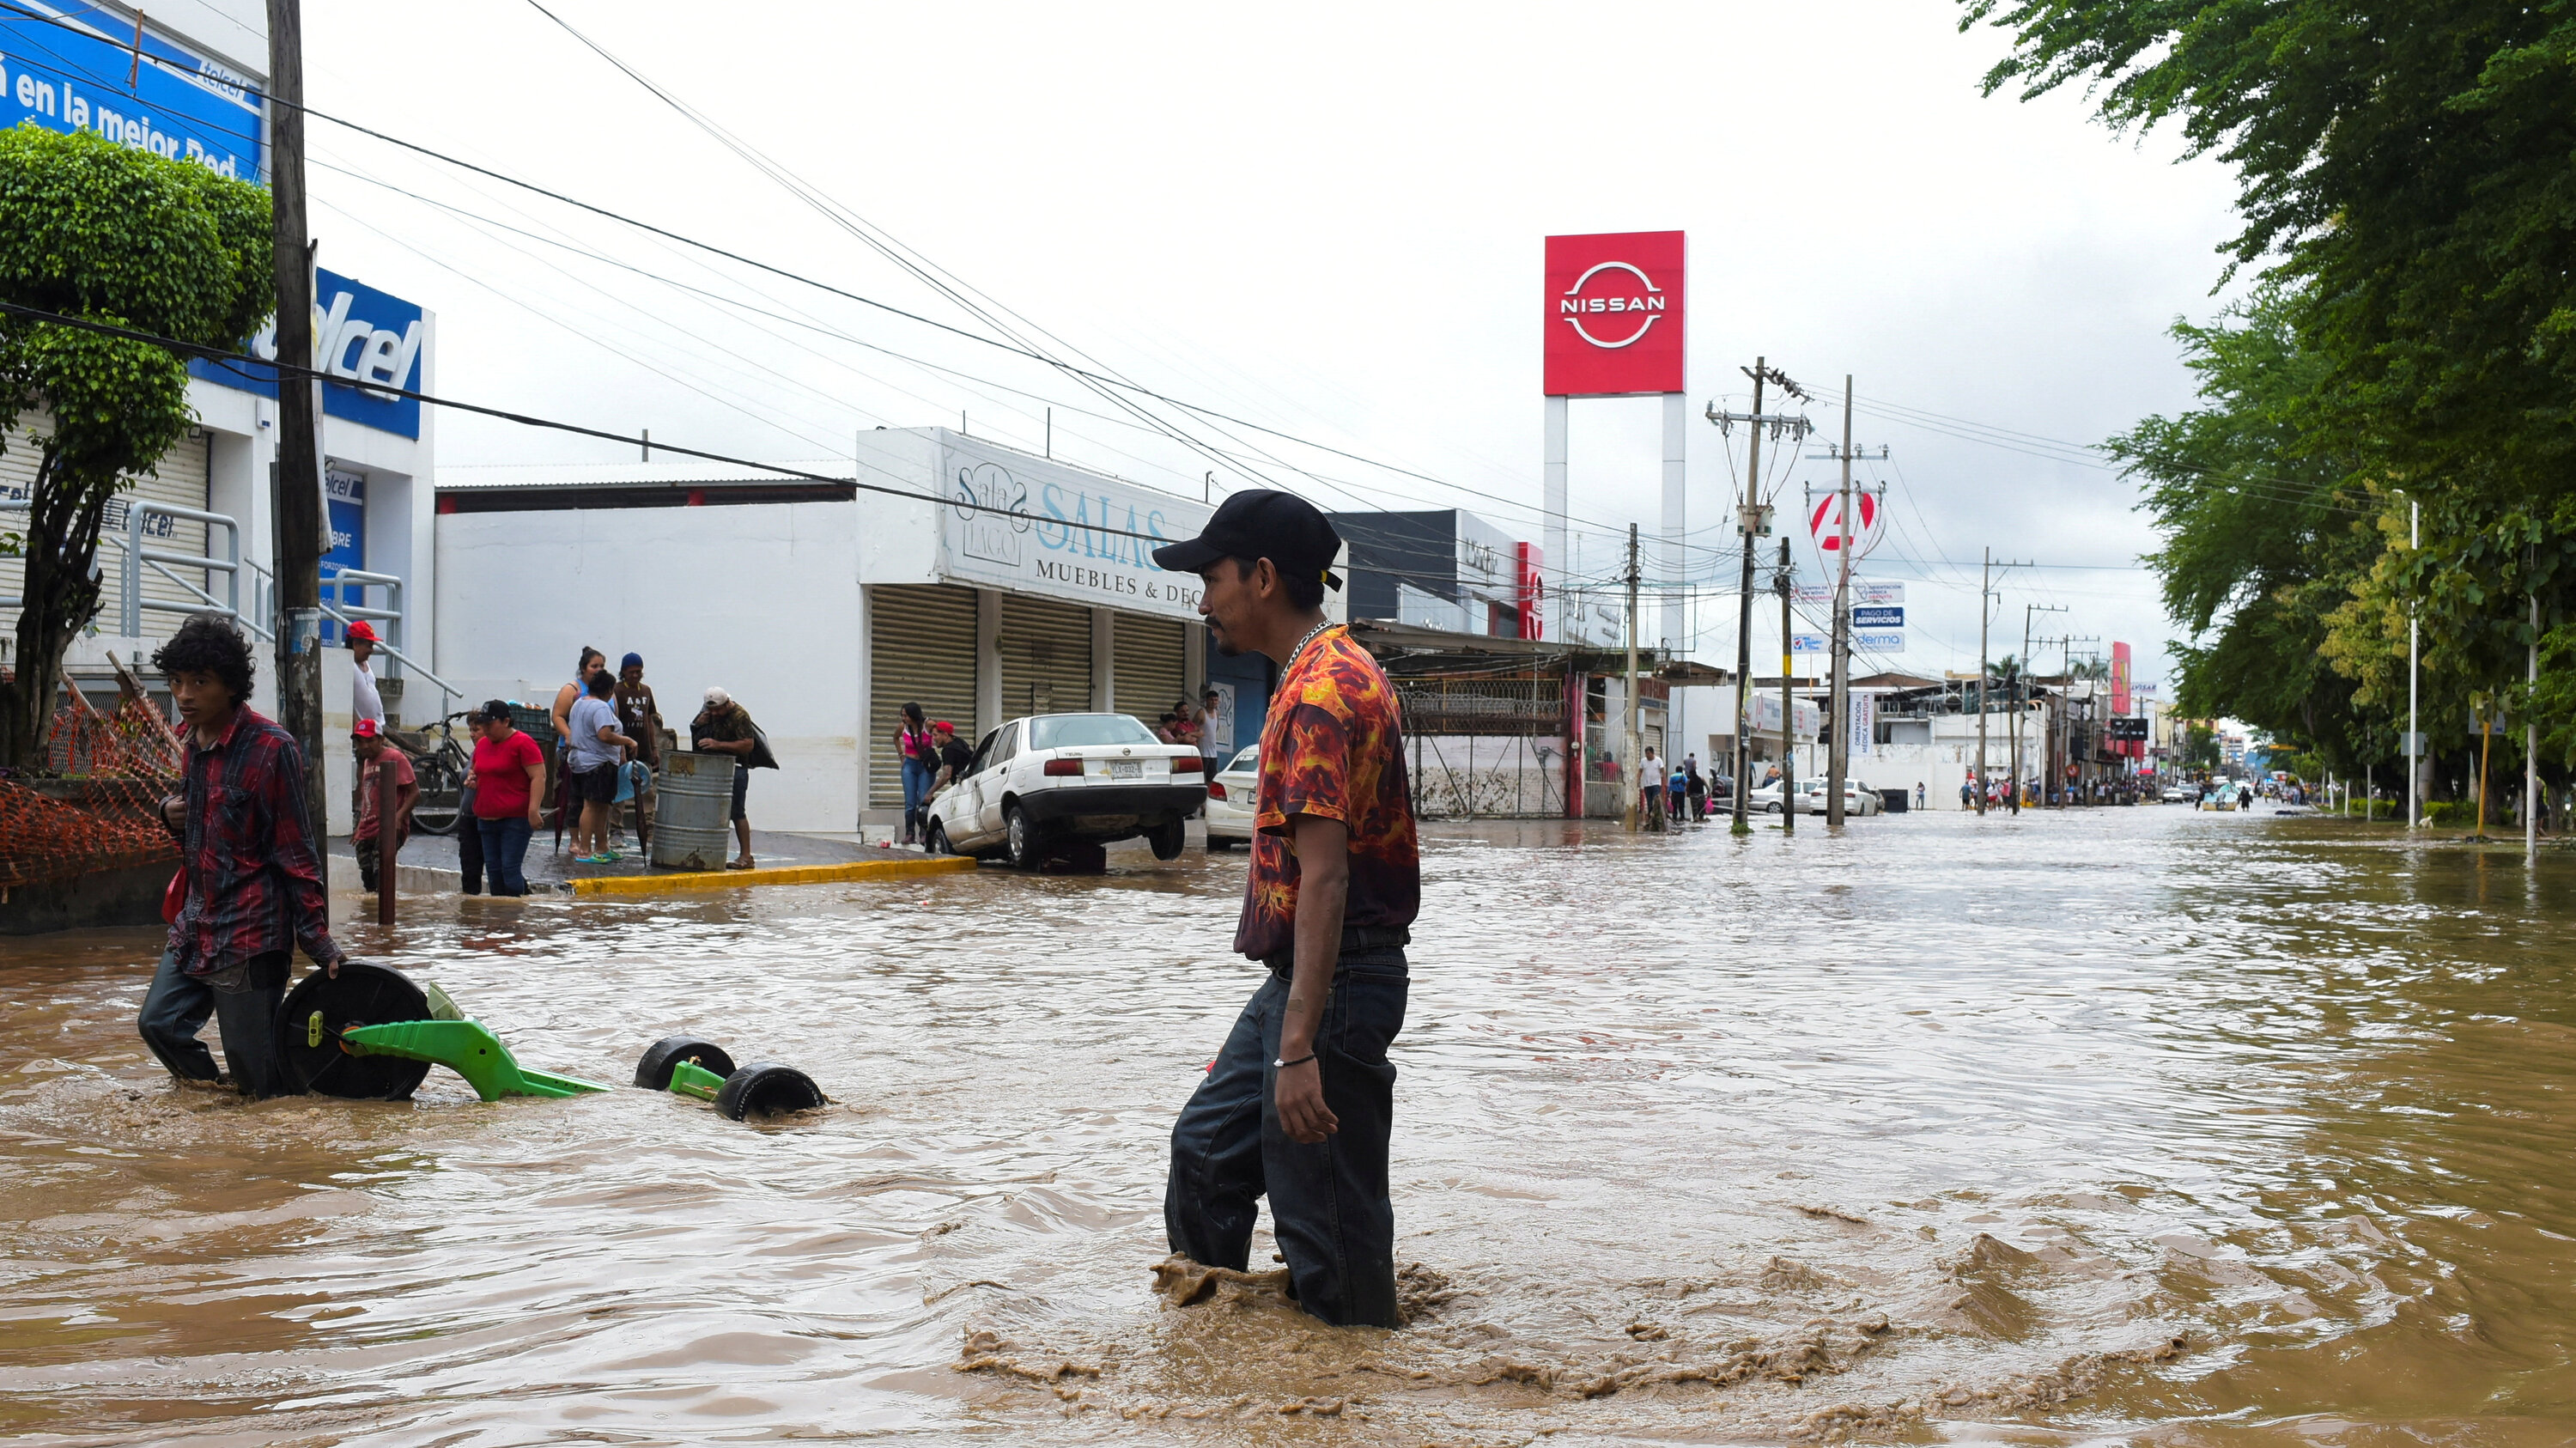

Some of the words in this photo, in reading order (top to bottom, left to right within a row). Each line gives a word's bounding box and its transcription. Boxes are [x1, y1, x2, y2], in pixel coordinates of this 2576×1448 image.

[202, 63, 244, 98] telcel
[16, 74, 55, 117] en
[64, 82, 89, 127] la
[98, 106, 179, 161] mejor
[1560, 296, 1665, 313] NISSAN
[252, 291, 423, 402] lcel
[122, 501, 174, 538] tlcel
[1036, 483, 1170, 572] SALAS
[1036, 559, 1136, 594] MUEBLES
[1145, 581, 1157, 599] &
[1166, 585, 1202, 607] DEC
[1856, 616, 1901, 624] SERVICIOS
[1857, 633, 1899, 644] derma
